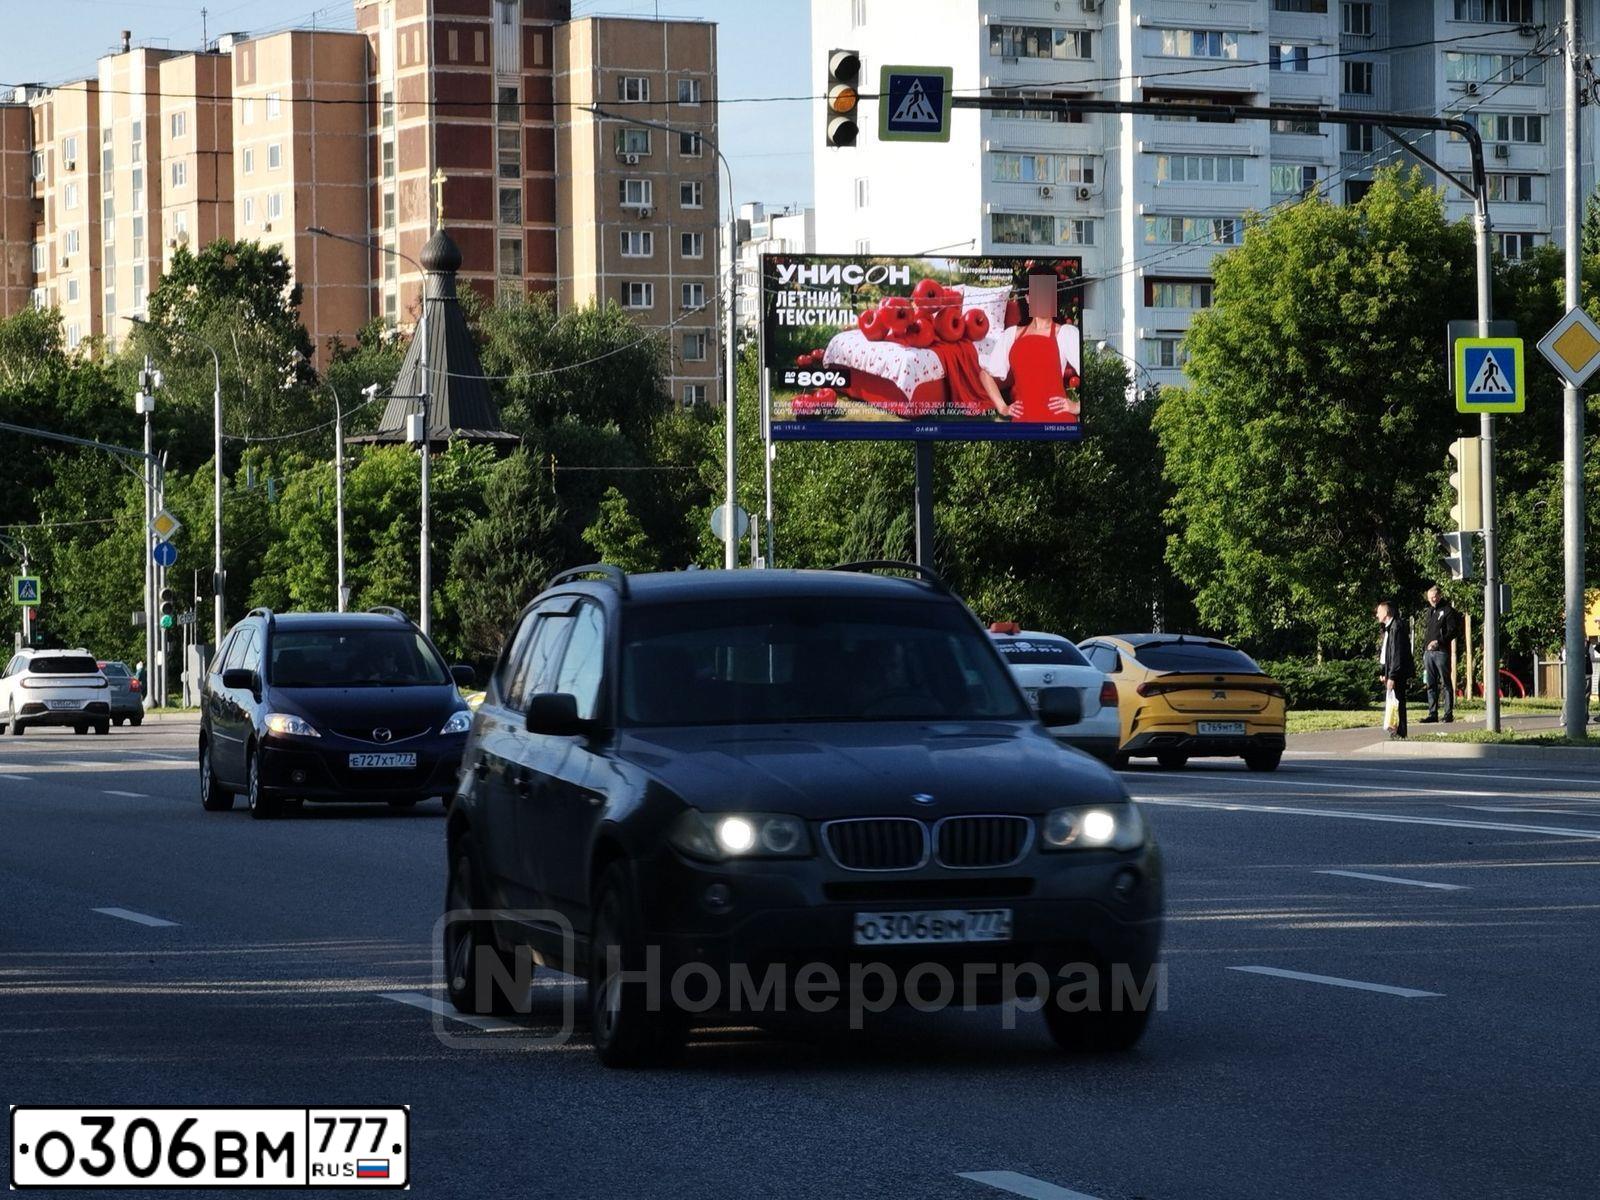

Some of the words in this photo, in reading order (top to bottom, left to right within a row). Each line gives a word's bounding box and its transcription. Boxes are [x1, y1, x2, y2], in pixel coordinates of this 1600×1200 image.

[776, 264, 910, 285] УНИСОН
[776, 287, 841, 307] ЛЕТНИЙ
[776, 309, 858, 326] ТЕКСТИЛЬ
[797, 371, 846, 387] 80%
[352, 755, 395, 766] Е727ХТ
[862, 913, 965, 940] О306ВМ
